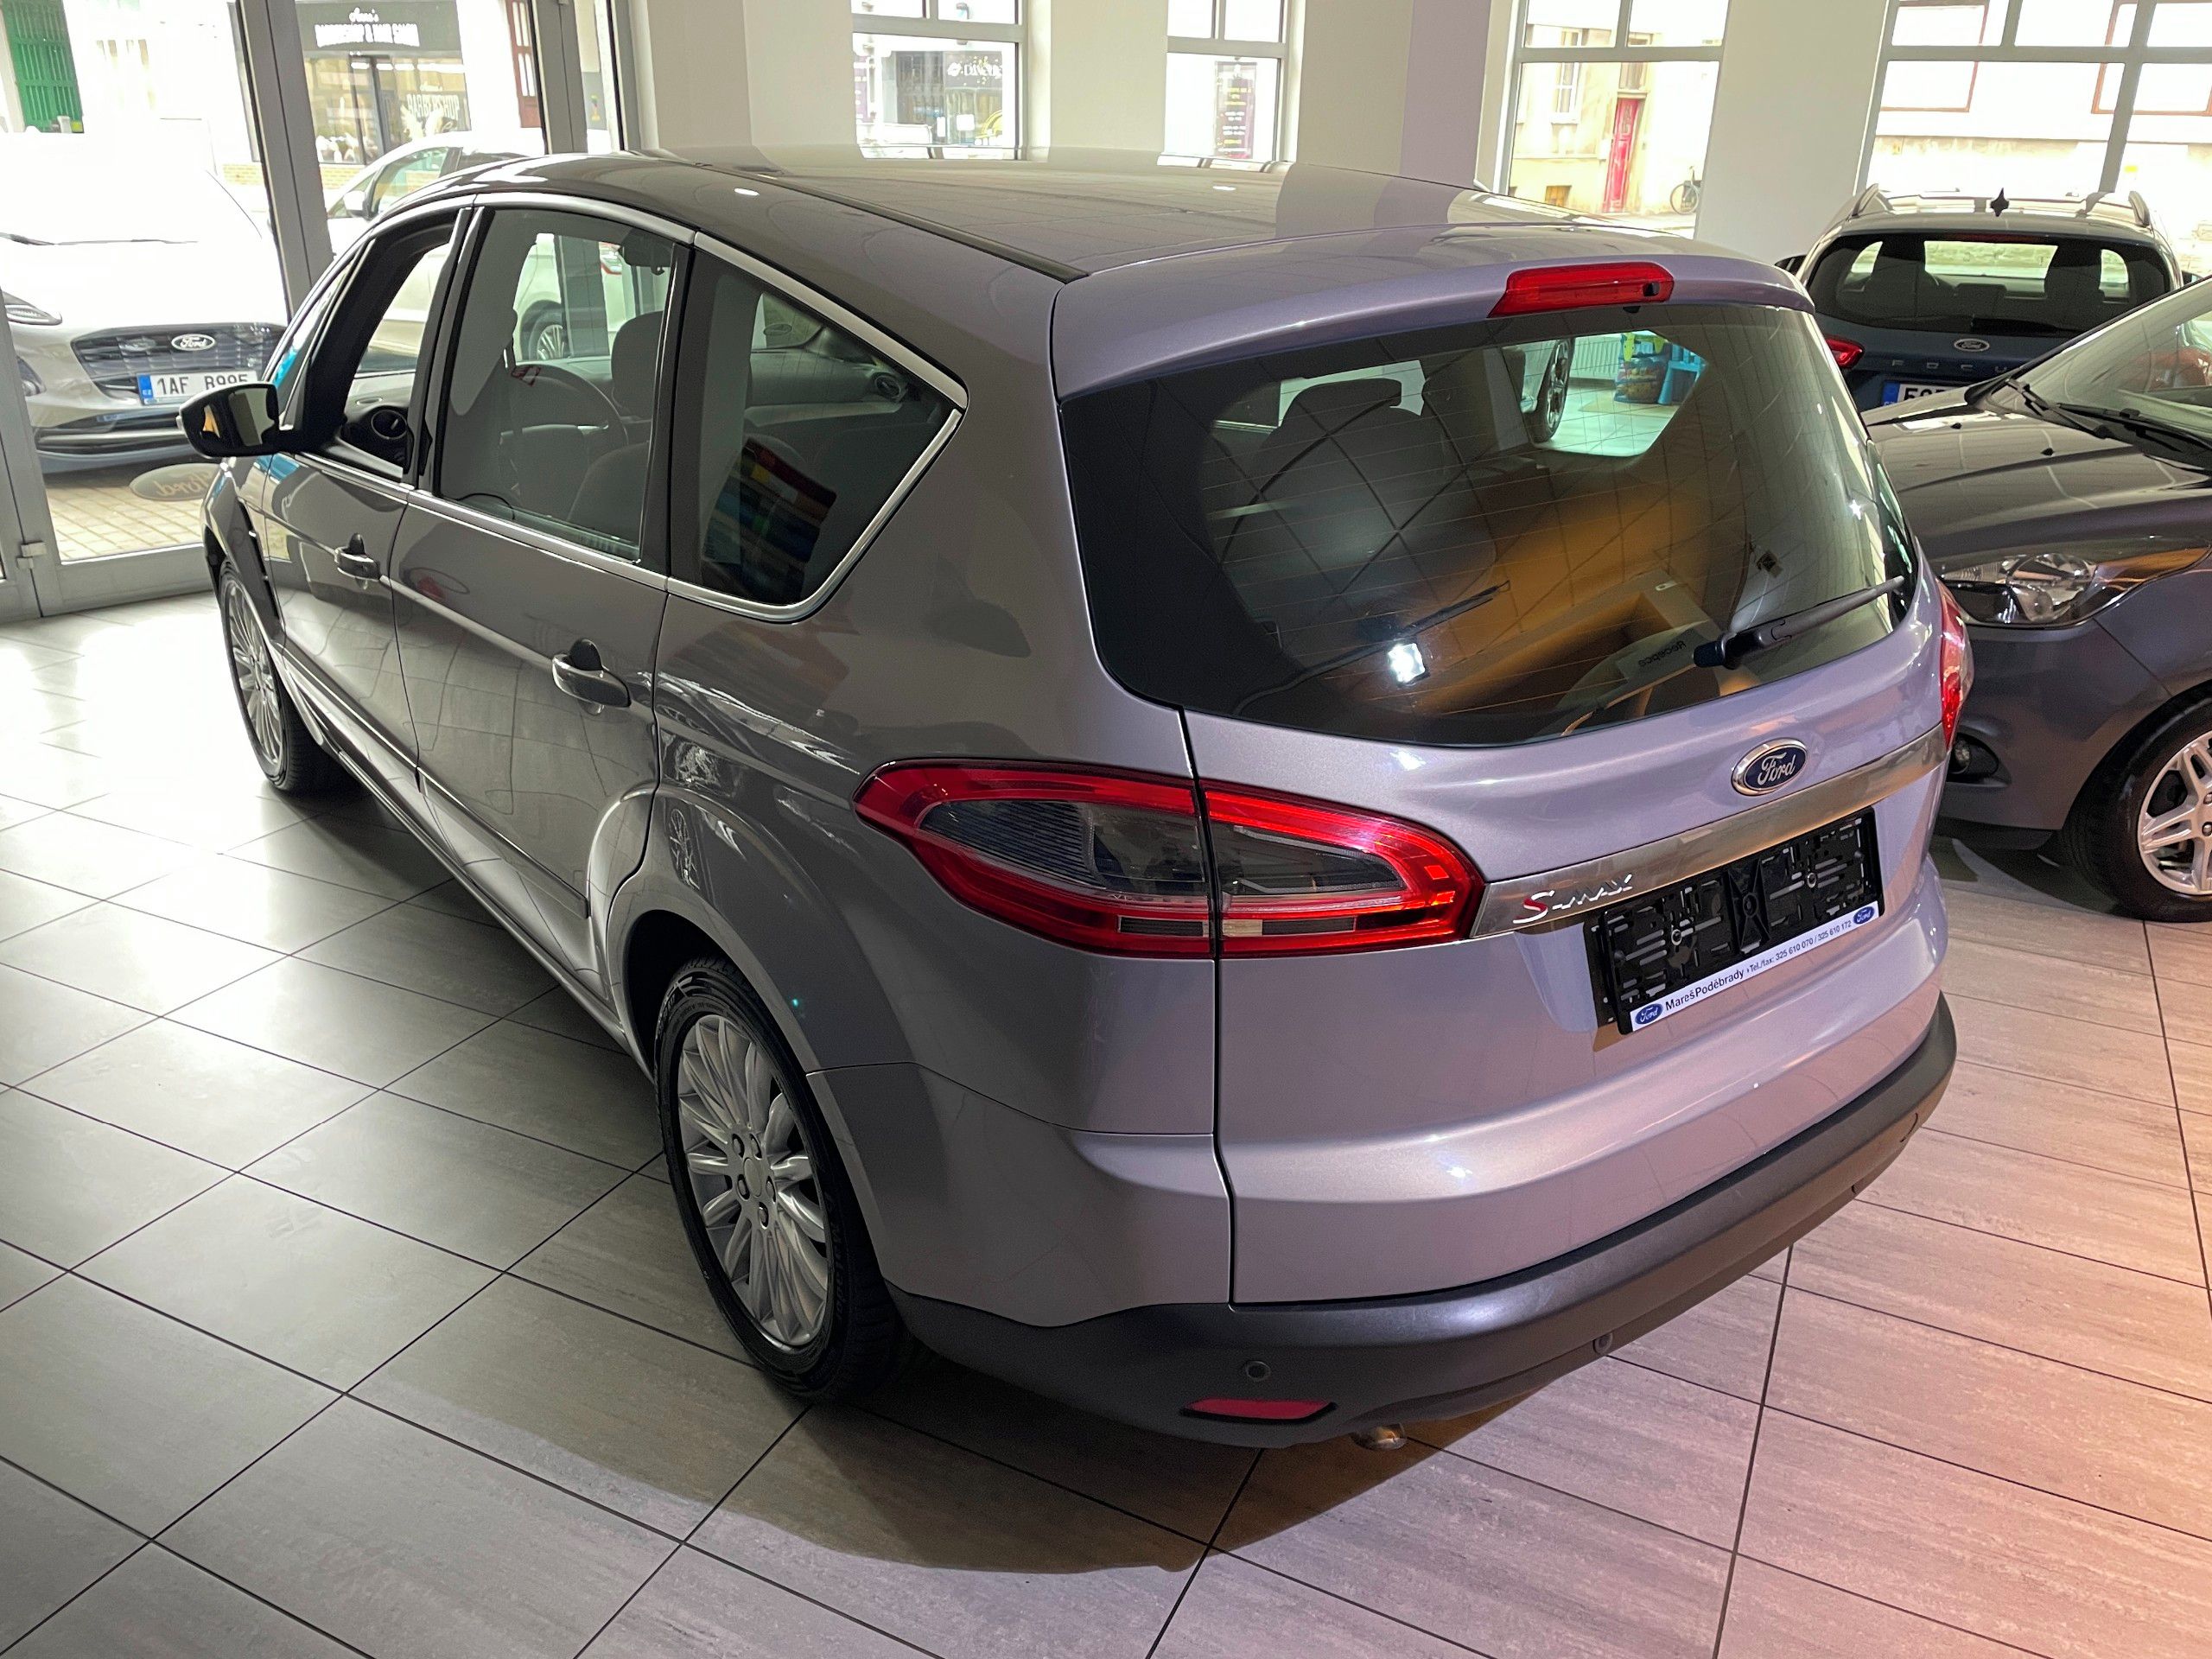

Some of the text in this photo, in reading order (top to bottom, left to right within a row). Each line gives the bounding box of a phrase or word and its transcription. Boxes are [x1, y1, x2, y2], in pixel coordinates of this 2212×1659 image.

[180, 337, 207, 348] Ford
[156, 377, 189, 395] 1AF
[1758, 752, 1796, 785] Ford
[1775, 950, 1788, 960] 325
[1789, 944, 1801, 954] 610
[1801, 938, 1814, 949] 070
[1818, 931, 1829, 941] 325
[1841, 920, 1852, 930] 172
